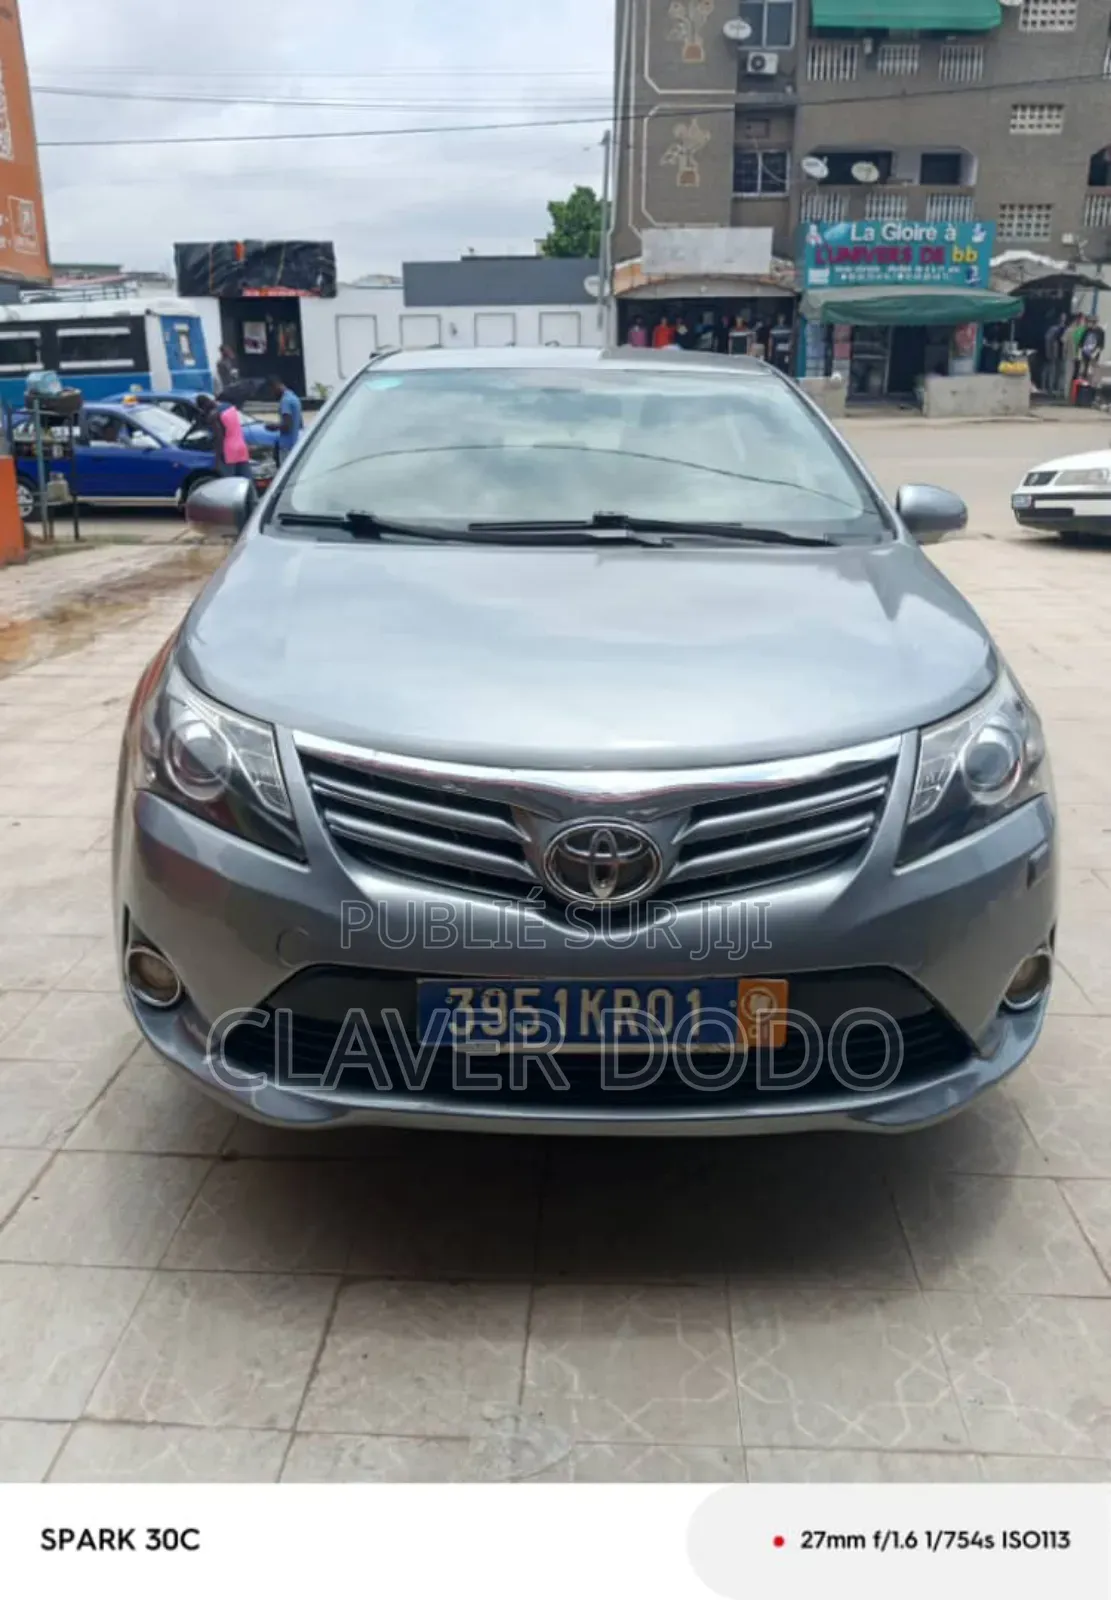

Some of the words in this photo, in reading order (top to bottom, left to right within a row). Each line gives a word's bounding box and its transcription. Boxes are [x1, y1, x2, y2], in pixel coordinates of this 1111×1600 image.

[850, 223, 875, 242] La
[881, 222, 938, 242] Gloire
[920, 246, 945, 264] DE
[951, 244, 978, 263] bb
[447, 987, 701, 1037] 3951KR01
